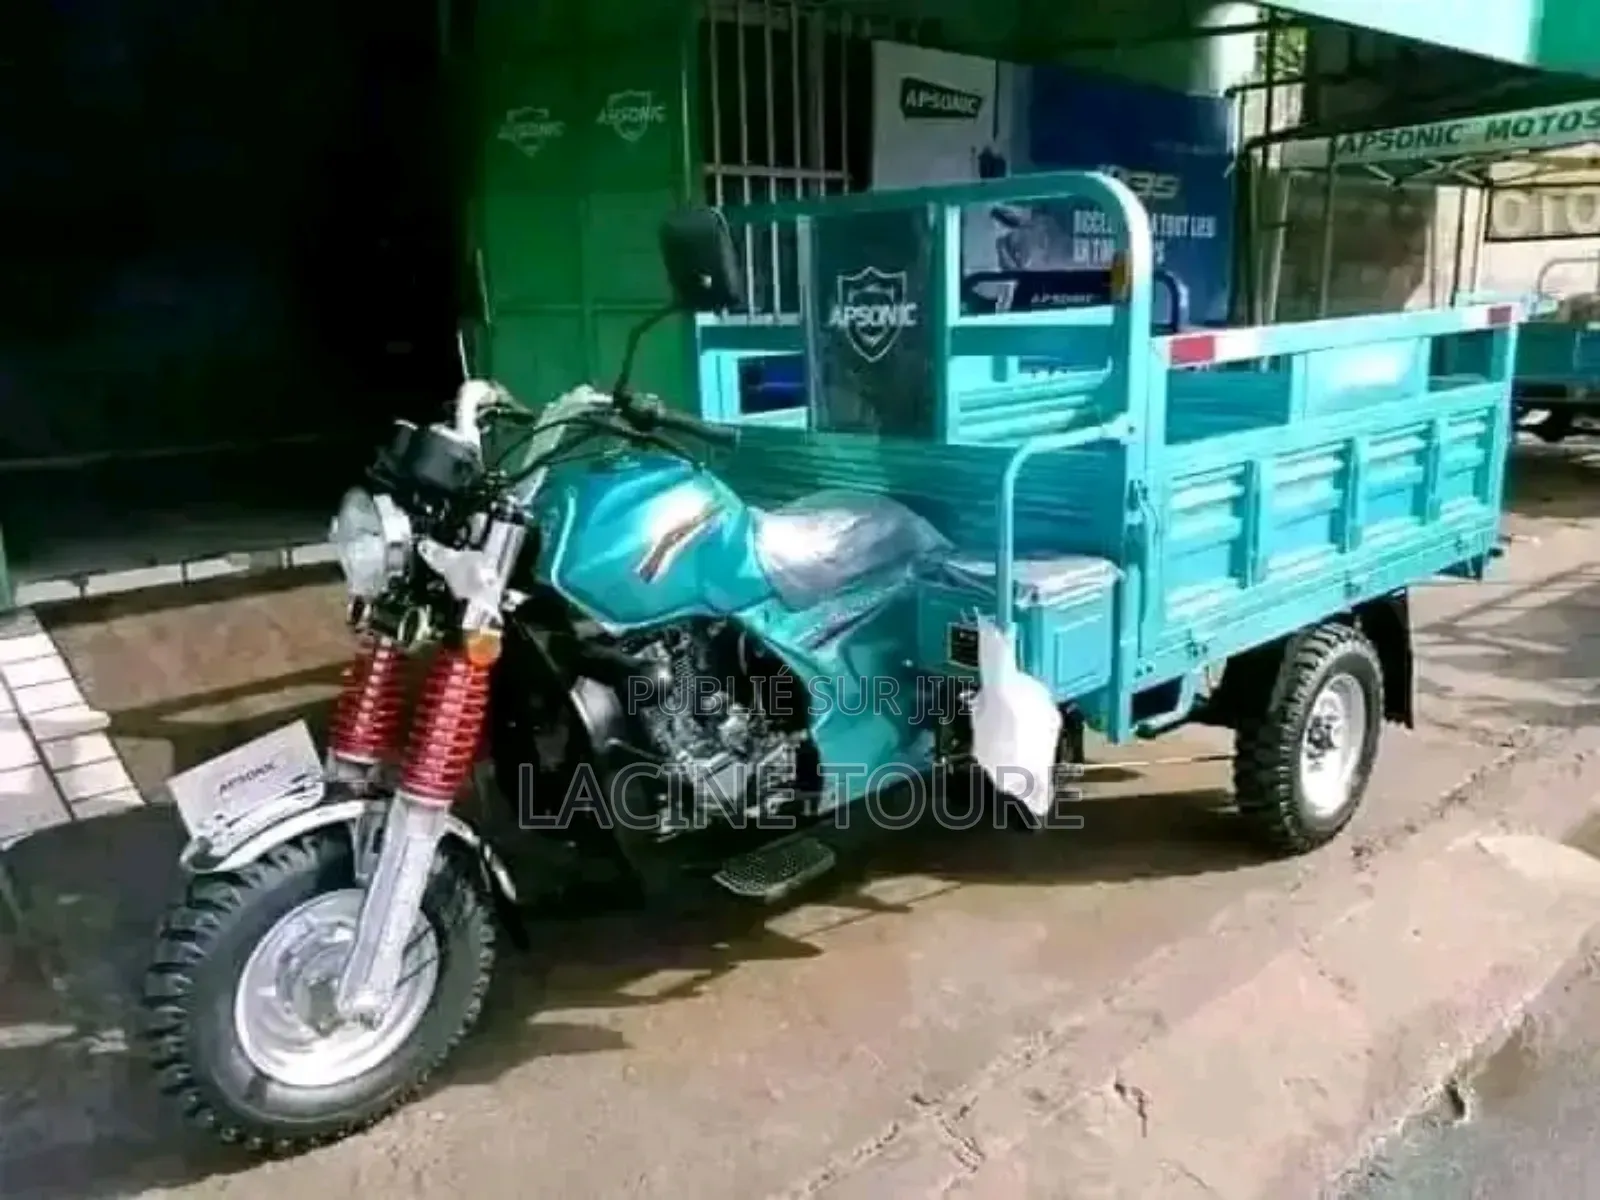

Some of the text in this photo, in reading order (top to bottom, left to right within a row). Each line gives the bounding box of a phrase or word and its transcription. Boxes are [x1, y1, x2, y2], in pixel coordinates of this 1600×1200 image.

[905, 88, 978, 115] APSONIC
[1335, 123, 1464, 157] APSONIC
[829, 302, 918, 330] APSONIC
